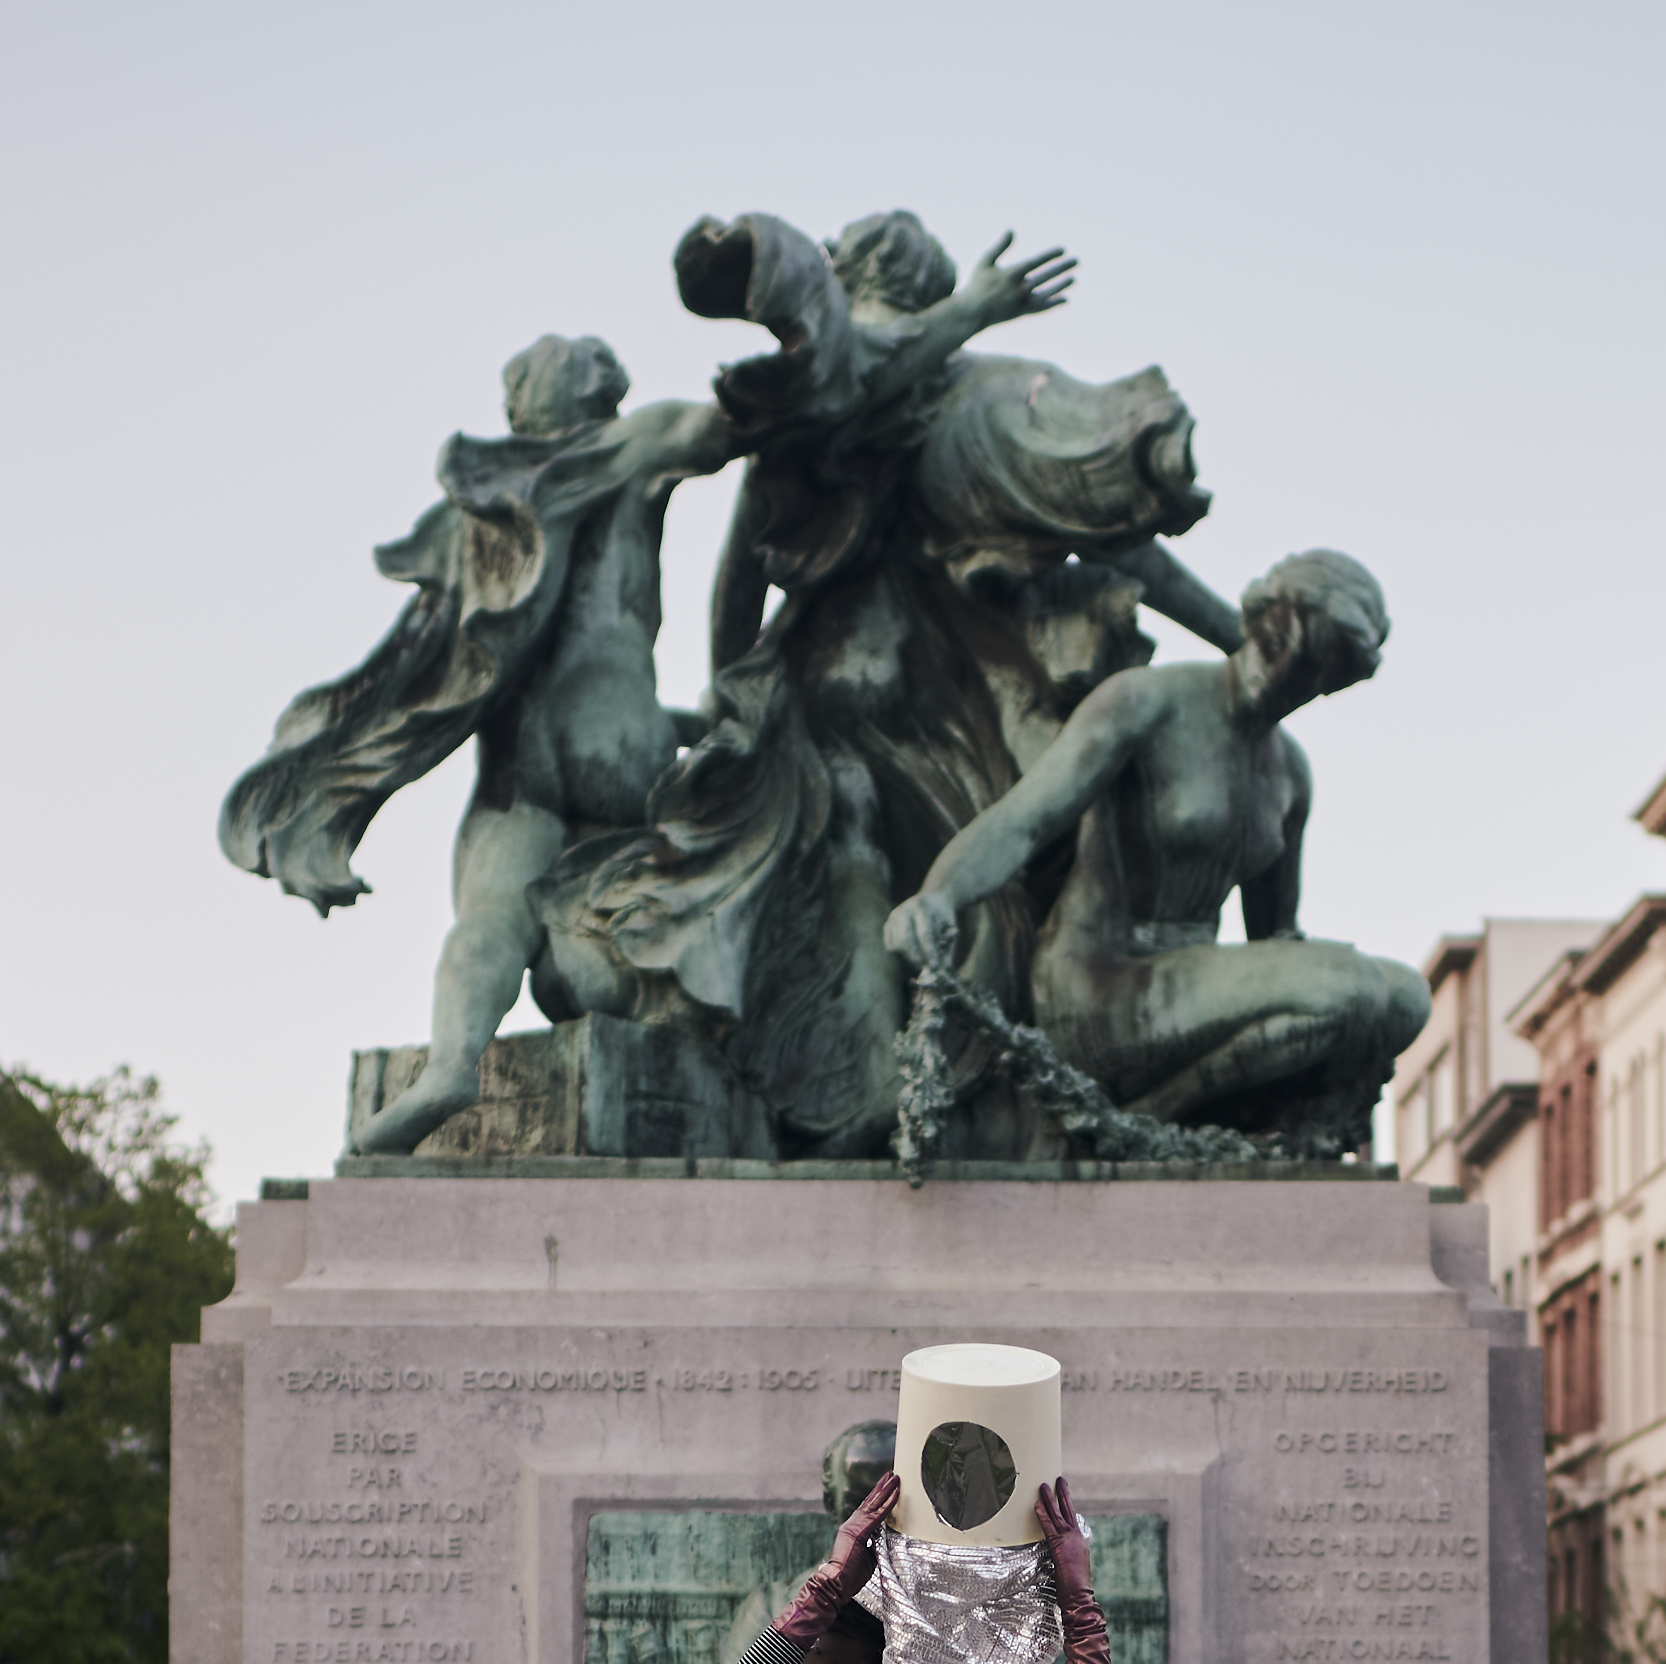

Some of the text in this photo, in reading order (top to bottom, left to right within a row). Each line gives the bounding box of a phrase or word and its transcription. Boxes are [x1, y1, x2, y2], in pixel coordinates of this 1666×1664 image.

[286, 1368, 444, 1392] EXPANSION
[462, 1368, 647, 1392] ECONOMIQUE
[674, 1367, 733, 1392] 1842
[757, 1367, 819, 1392] 1905
[1061, 1368, 1098, 1392] AN
[1110, 1369, 1220, 1393] HANDEL
[1234, 1369, 1272, 1393] EN
[347, 1466, 403, 1489] PAR
[260, 1502, 488, 1525] SOUSCRIPTION
[1276, 1502, 1453, 1524] NATIONALE
[284, 1536, 463, 1559] NATIONALE
[1249, 1570, 1479, 1593] DOOR TOEDOEN
[327, 1605, 417, 1629] DE LA
[1296, 1604, 1434, 1627] VAN HET
[272, 1640, 476, 1664] FEDERATION
[1277, 1639, 1451, 1661] NATIONAAL
